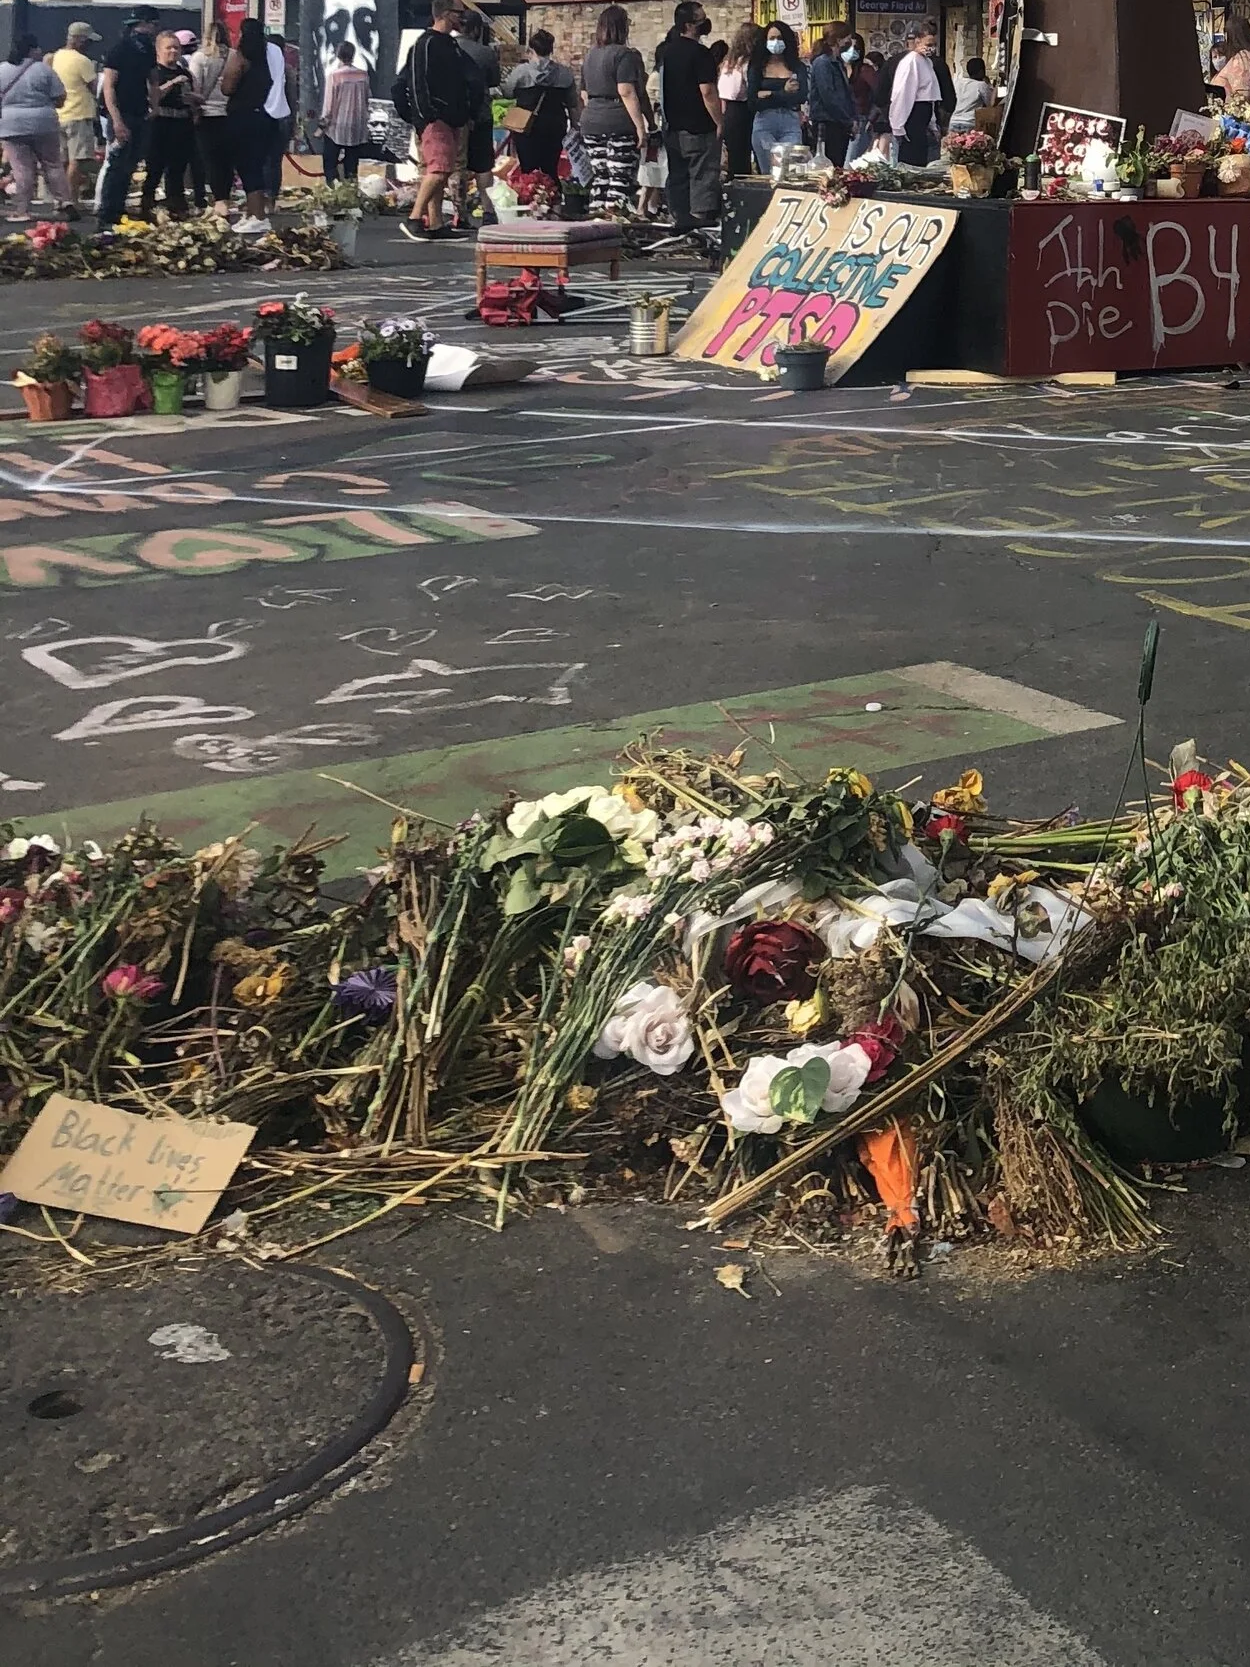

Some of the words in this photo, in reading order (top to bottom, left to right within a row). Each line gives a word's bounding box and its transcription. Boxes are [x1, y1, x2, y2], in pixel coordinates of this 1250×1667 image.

[765, 196, 837, 249] THIS
[878, 211, 946, 268] OUR
[748, 243, 912, 309] COLLECTIVE
[702, 285, 861, 367] PTSD
[51, 1109, 136, 1157] Black
[146, 1136, 206, 1174] lives
[36, 1161, 144, 1203] Matter
